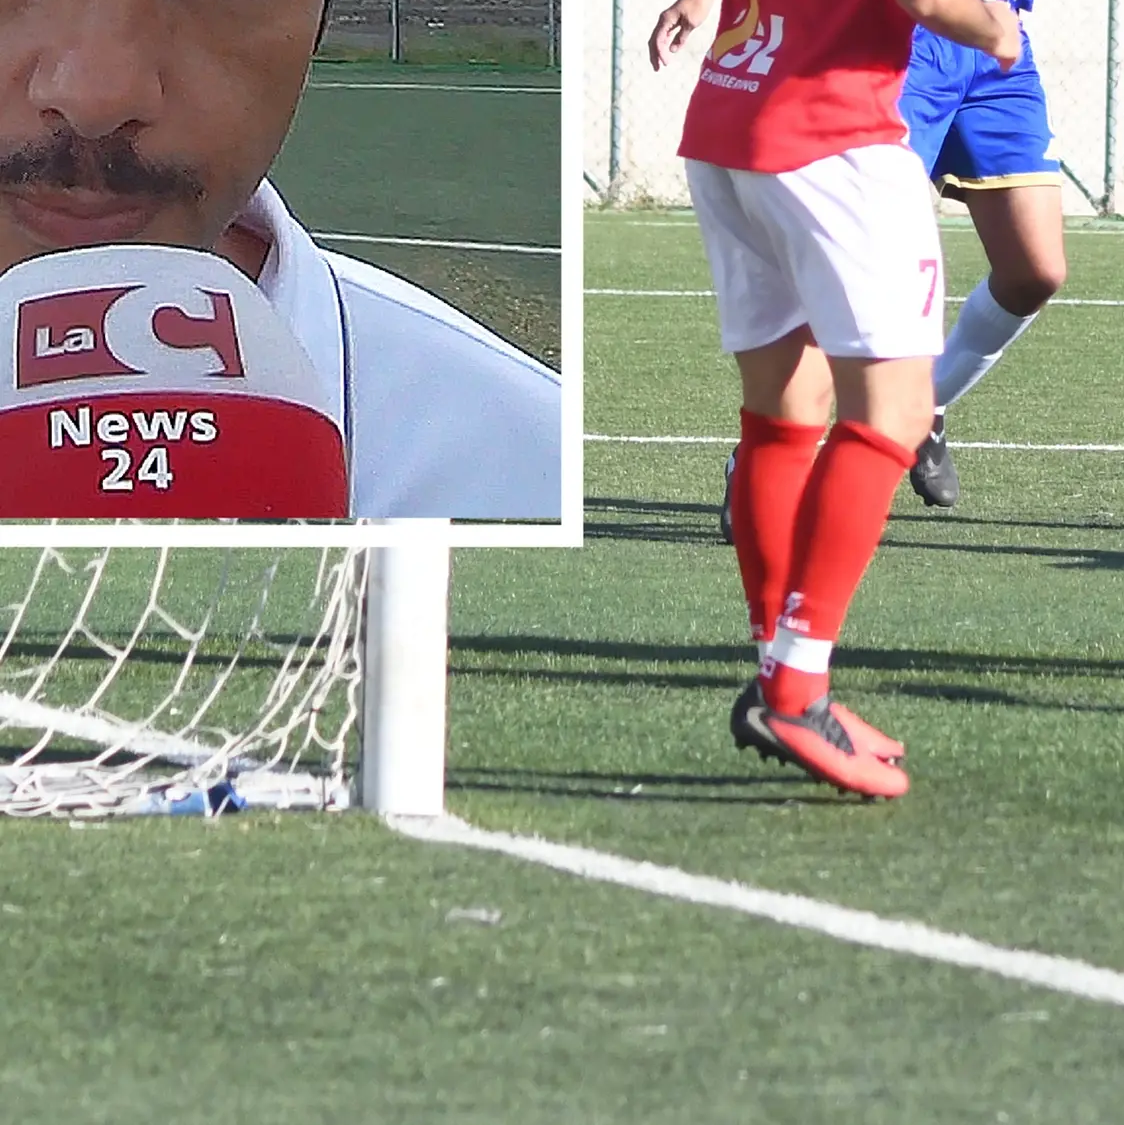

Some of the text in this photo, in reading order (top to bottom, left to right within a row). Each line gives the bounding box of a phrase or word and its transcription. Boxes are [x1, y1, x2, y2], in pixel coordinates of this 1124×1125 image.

[919, 259, 938, 317] 7
[35, 325, 95, 358] La
[50, 406, 218, 448] News
[100, 446, 174, 491] 24
